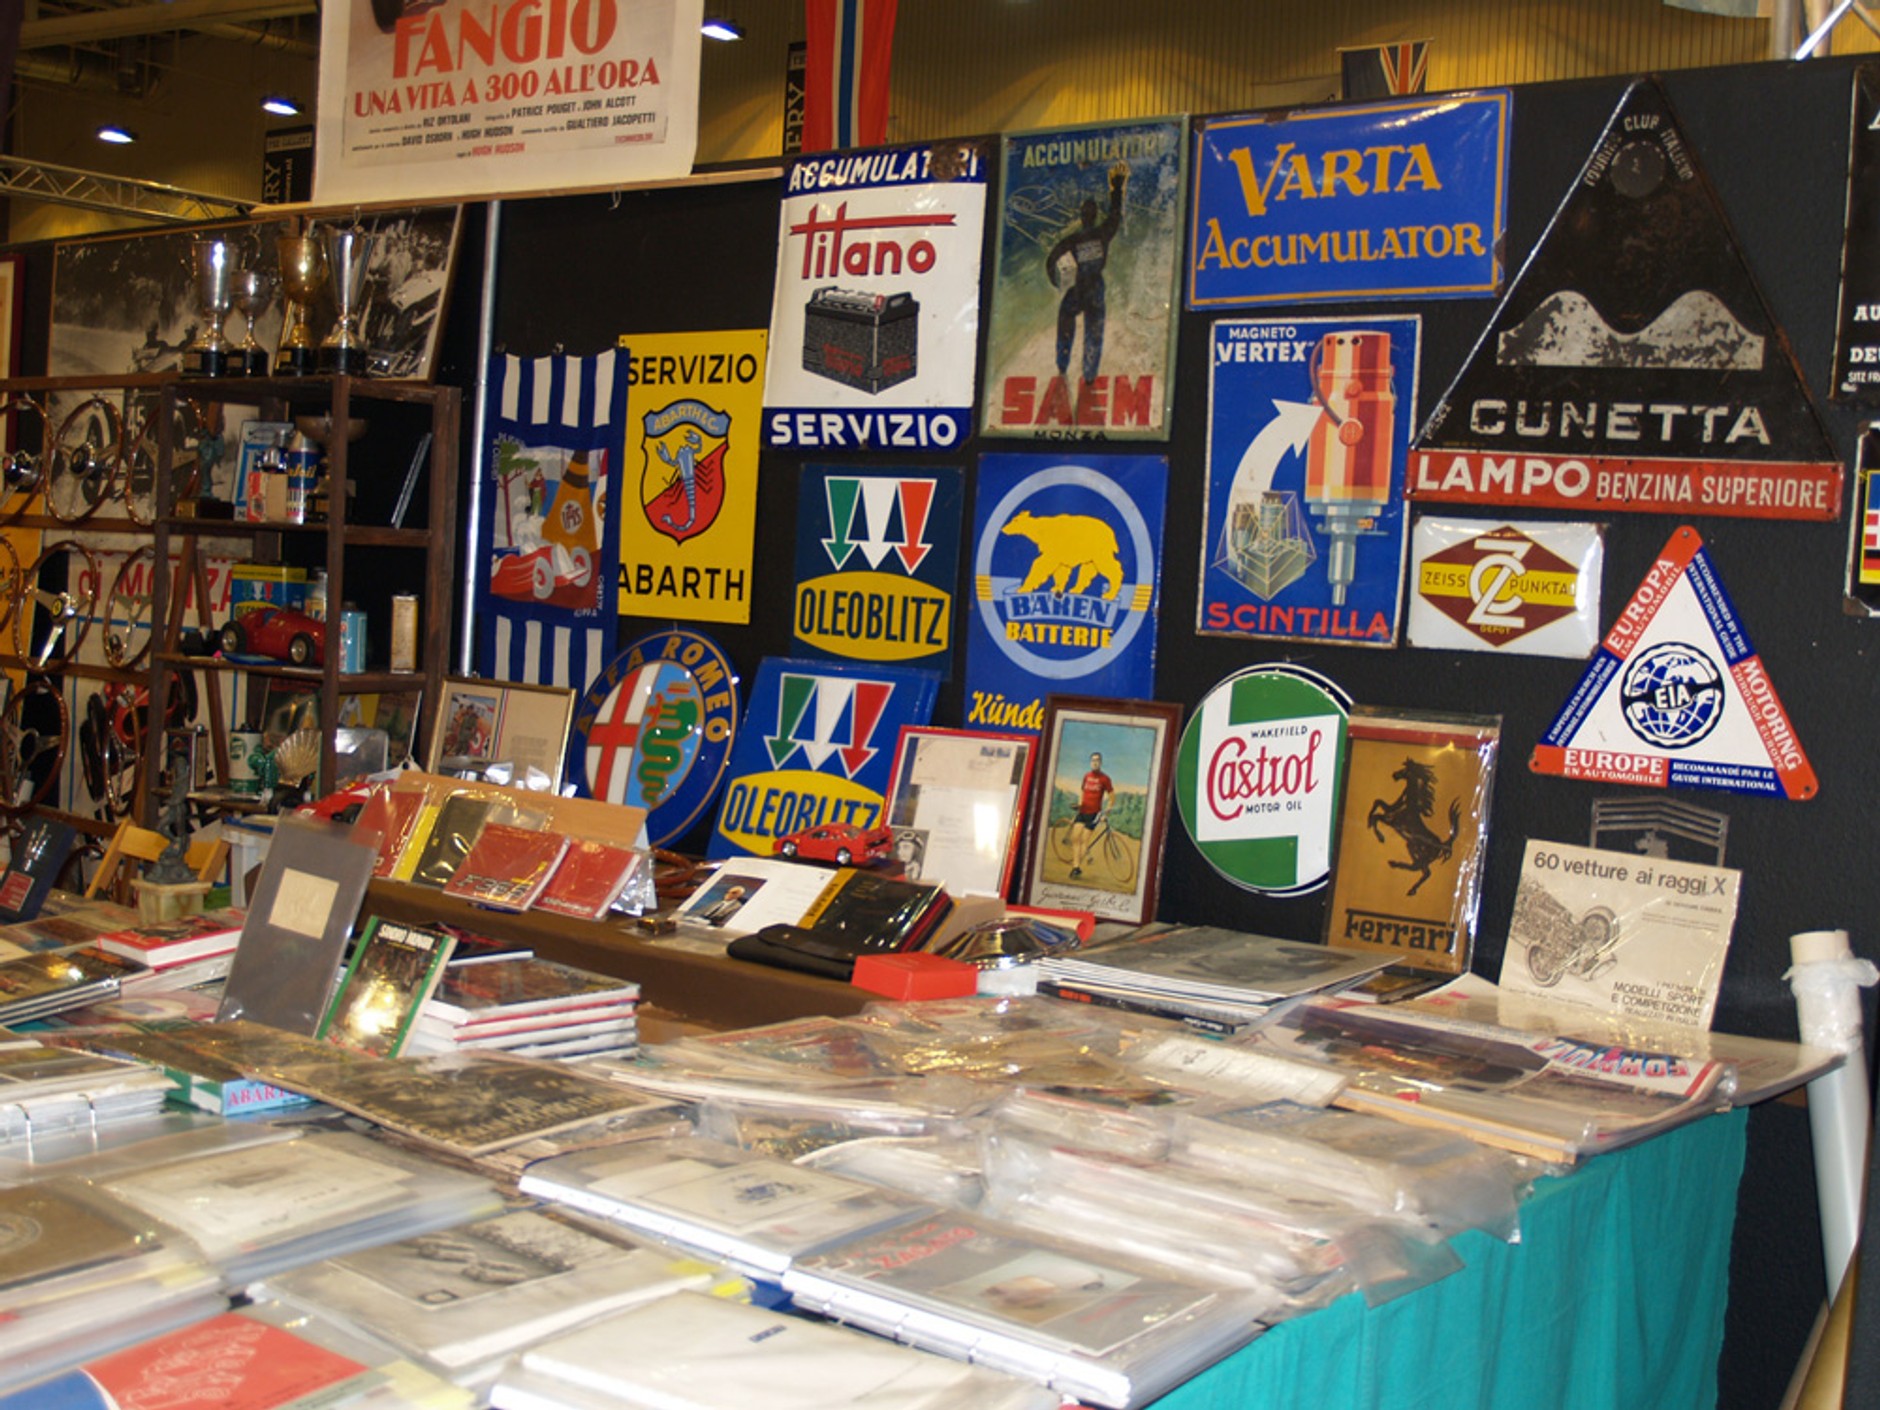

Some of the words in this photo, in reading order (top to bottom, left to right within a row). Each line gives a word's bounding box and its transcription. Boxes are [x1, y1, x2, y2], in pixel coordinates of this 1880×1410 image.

[393, 0, 617, 79] FANGIO
[354, 90, 401, 118] UNA
[406, 78, 456, 112] VITA
[460, 87, 479, 105] A
[485, 70, 539, 102] 300
[511, 105, 544, 119] PATRICE
[605, 95, 637, 109] ALCOTT
[566, 116, 608, 131] GUALTIERO
[611, 112, 656, 127] JACOPETTI
[788, 148, 979, 192] ACCUMULATRI
[1228, 141, 1443, 217] VARTA
[1197, 218, 1486, 271] ACCUMULATOR
[1228, 326, 1297, 340] MAGNETO
[628, 354, 758, 386] SERVIZIO
[1001, 374, 1155, 426] SAEM
[771, 412, 958, 447] SERVIZIO
[1033, 429, 1109, 442] MONZA
[1470, 399, 1771, 446] CUNETTA
[1417, 455, 1591, 498] LAMPO
[1597, 471, 1693, 502] BENZINA
[1701, 474, 1829, 509] SUPERIORE
[618, 562, 745, 602] ABARTH
[1424, 571, 1467, 589] ZEISS
[799, 587, 947, 647] OLEOBLITZ
[1206, 602, 1391, 639] SCINTILLA
[1606, 558, 1675, 651] EUROPA
[1005, 621, 1114, 649] BATTERIE
[661, 636, 731, 744] ROMEO
[1655, 686, 1691, 710] EIA
[1251, 725, 1309, 739] WAKEFIELD
[1741, 660, 1803, 772] MOTORING
[1207, 730, 1322, 822] Castrol
[1564, 750, 1663, 775] EUROPE
[1763, 770, 1774, 780] LE
[1564, 766, 1580, 777] EN
[1584, 769, 1663, 785] AUTOMOBILE
[1672, 773, 1700, 784] GUIDE
[1701, 775, 1776, 792] INTERNATIONAL
[1245, 802, 1281, 815] MOTOR
[1286, 800, 1303, 812] OIL
[1534, 852, 1560, 871] 60
[1563, 856, 1628, 882] vetture
[1635, 867, 1654, 886] ai
[1658, 872, 1708, 897] raggi
[1711, 877, 1727, 896] X
[1344, 908, 1457, 954] Ferrari
[1611, 993, 1619, 1004] E
[1613, 981, 1661, 999] MODELLI
[1666, 990, 1704, 1006] SPORT
